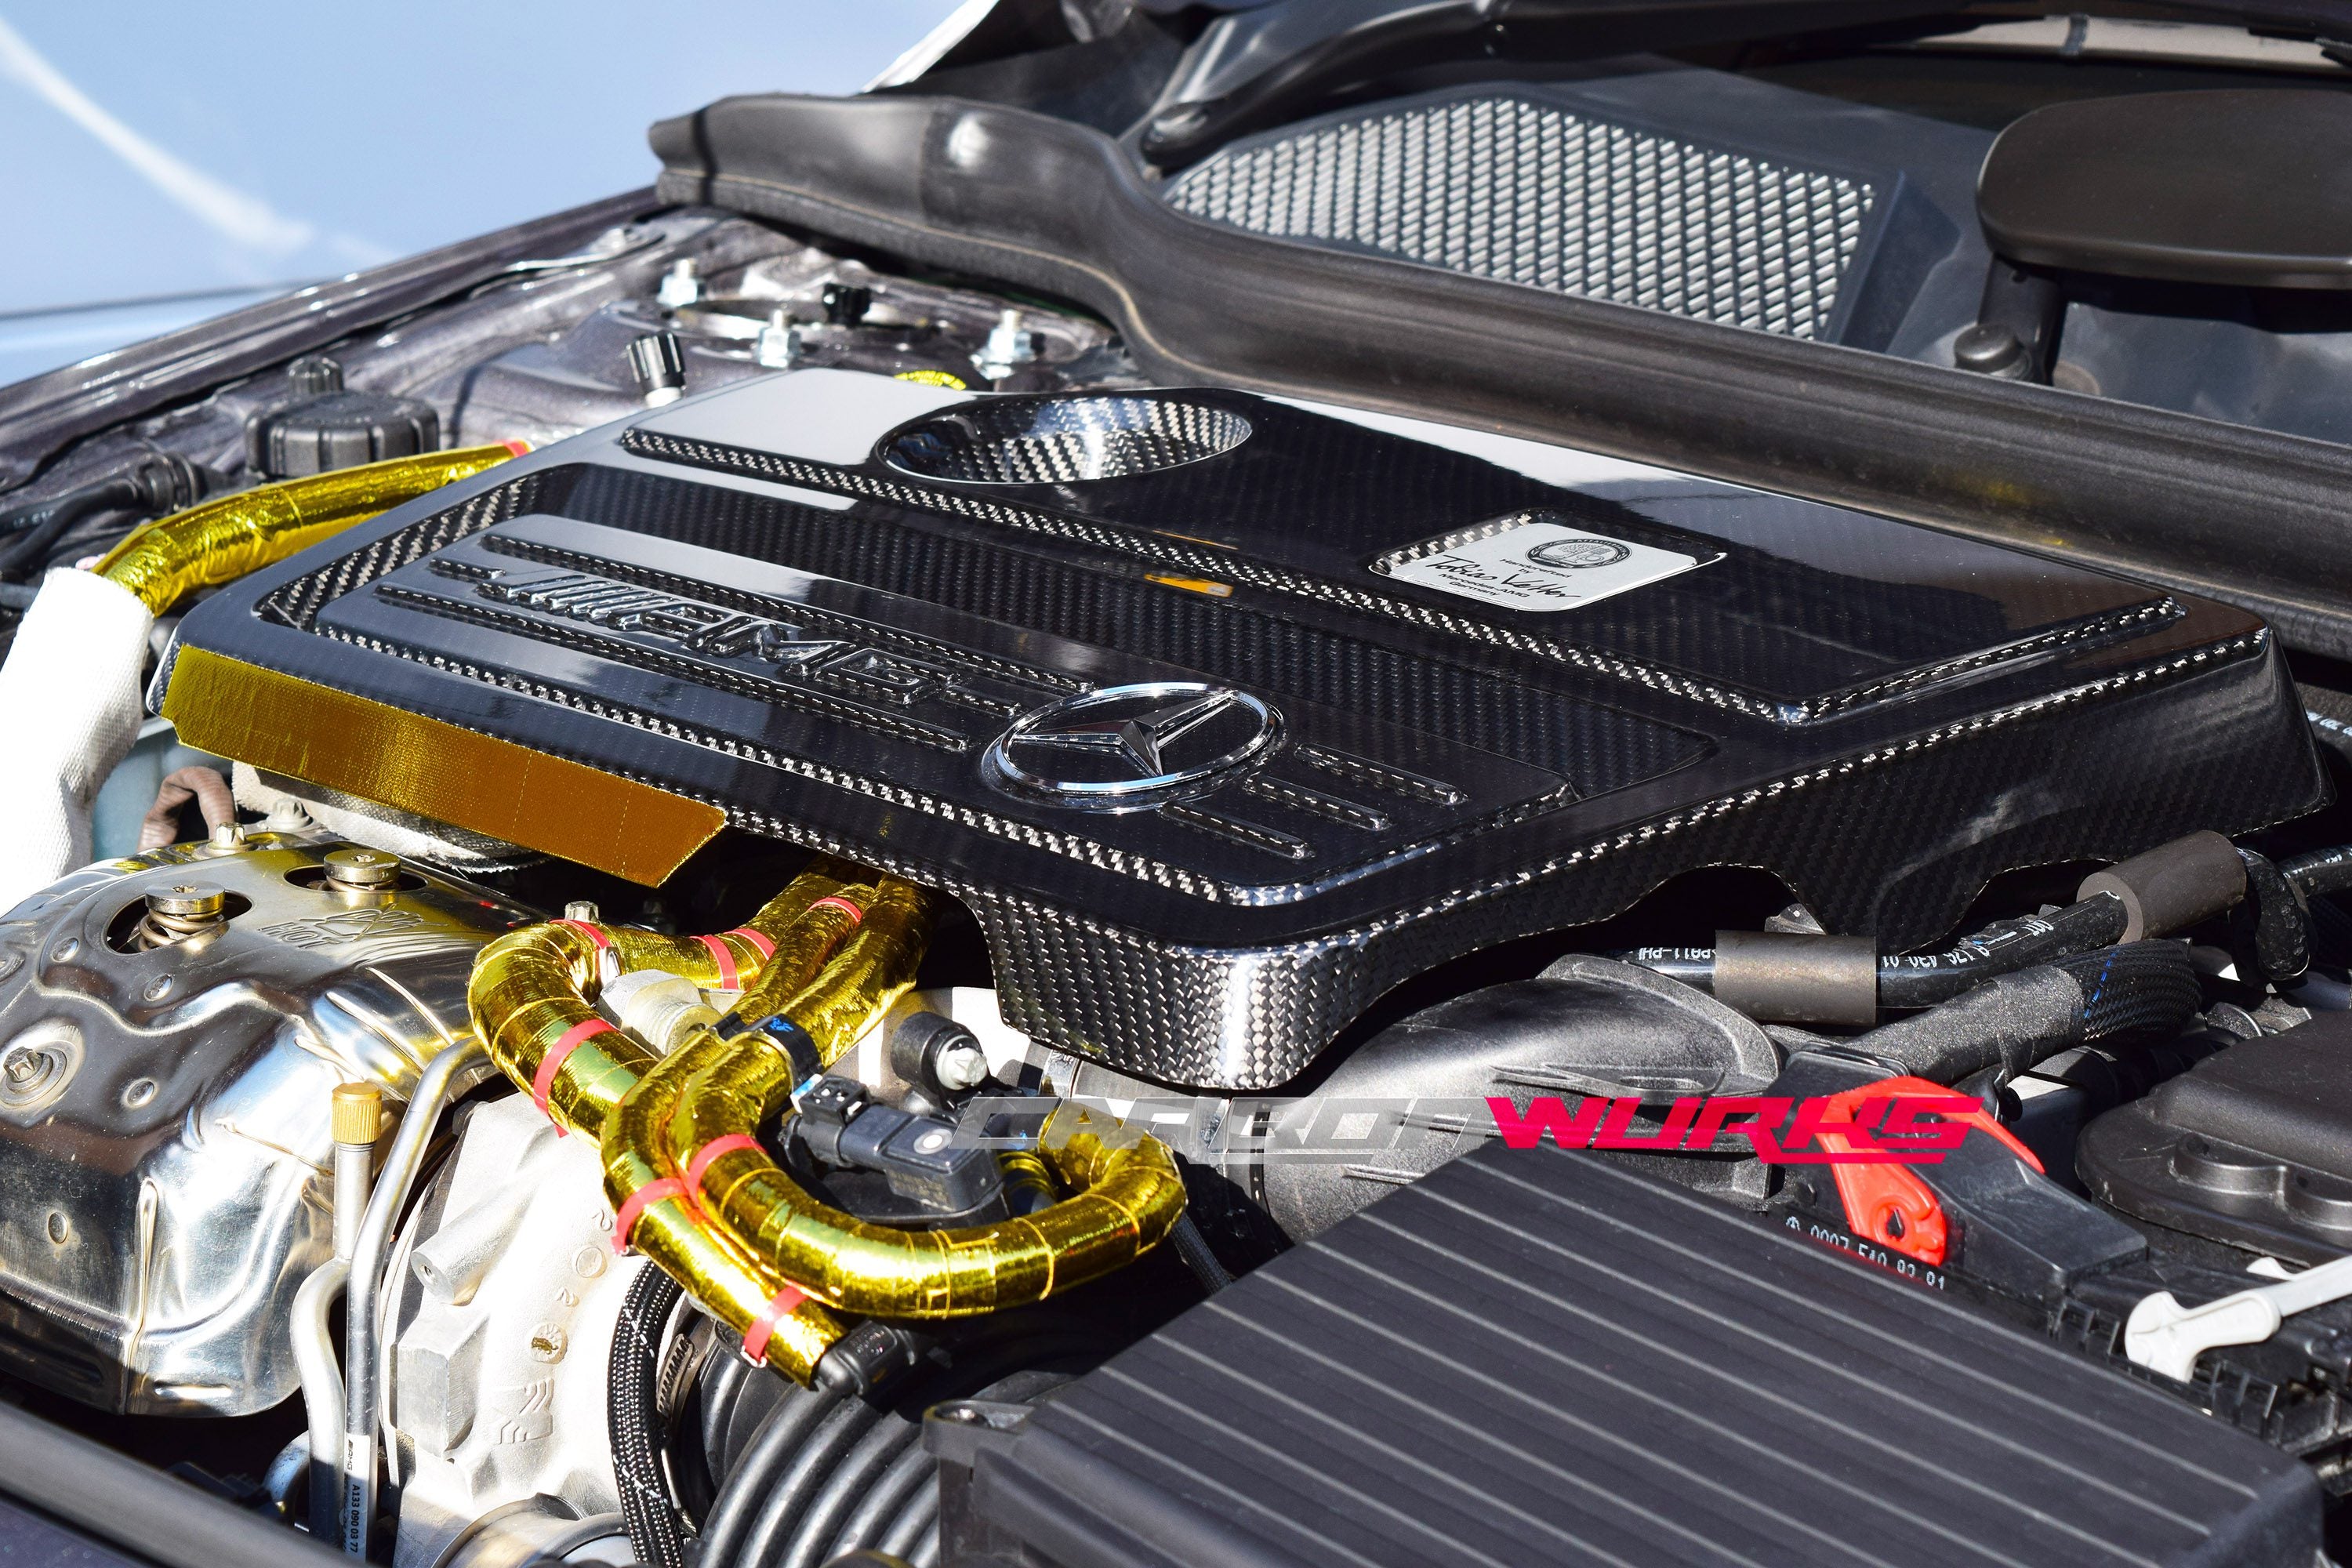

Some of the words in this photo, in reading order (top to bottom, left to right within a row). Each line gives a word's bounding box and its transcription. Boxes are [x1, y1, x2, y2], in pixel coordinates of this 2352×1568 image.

[1499, 558, 1572, 578] Handcrafted
[1438, 573, 1530, 597] Mercedes-AMG
[1450, 581, 1501, 596] Germany
[256, 921, 343, 949] HOT
[351, 1483, 361, 1508] A133
[350, 1510, 360, 1526] 090
[350, 1528, 359, 1539] 03
[350, 1541, 358, 1553] 77
